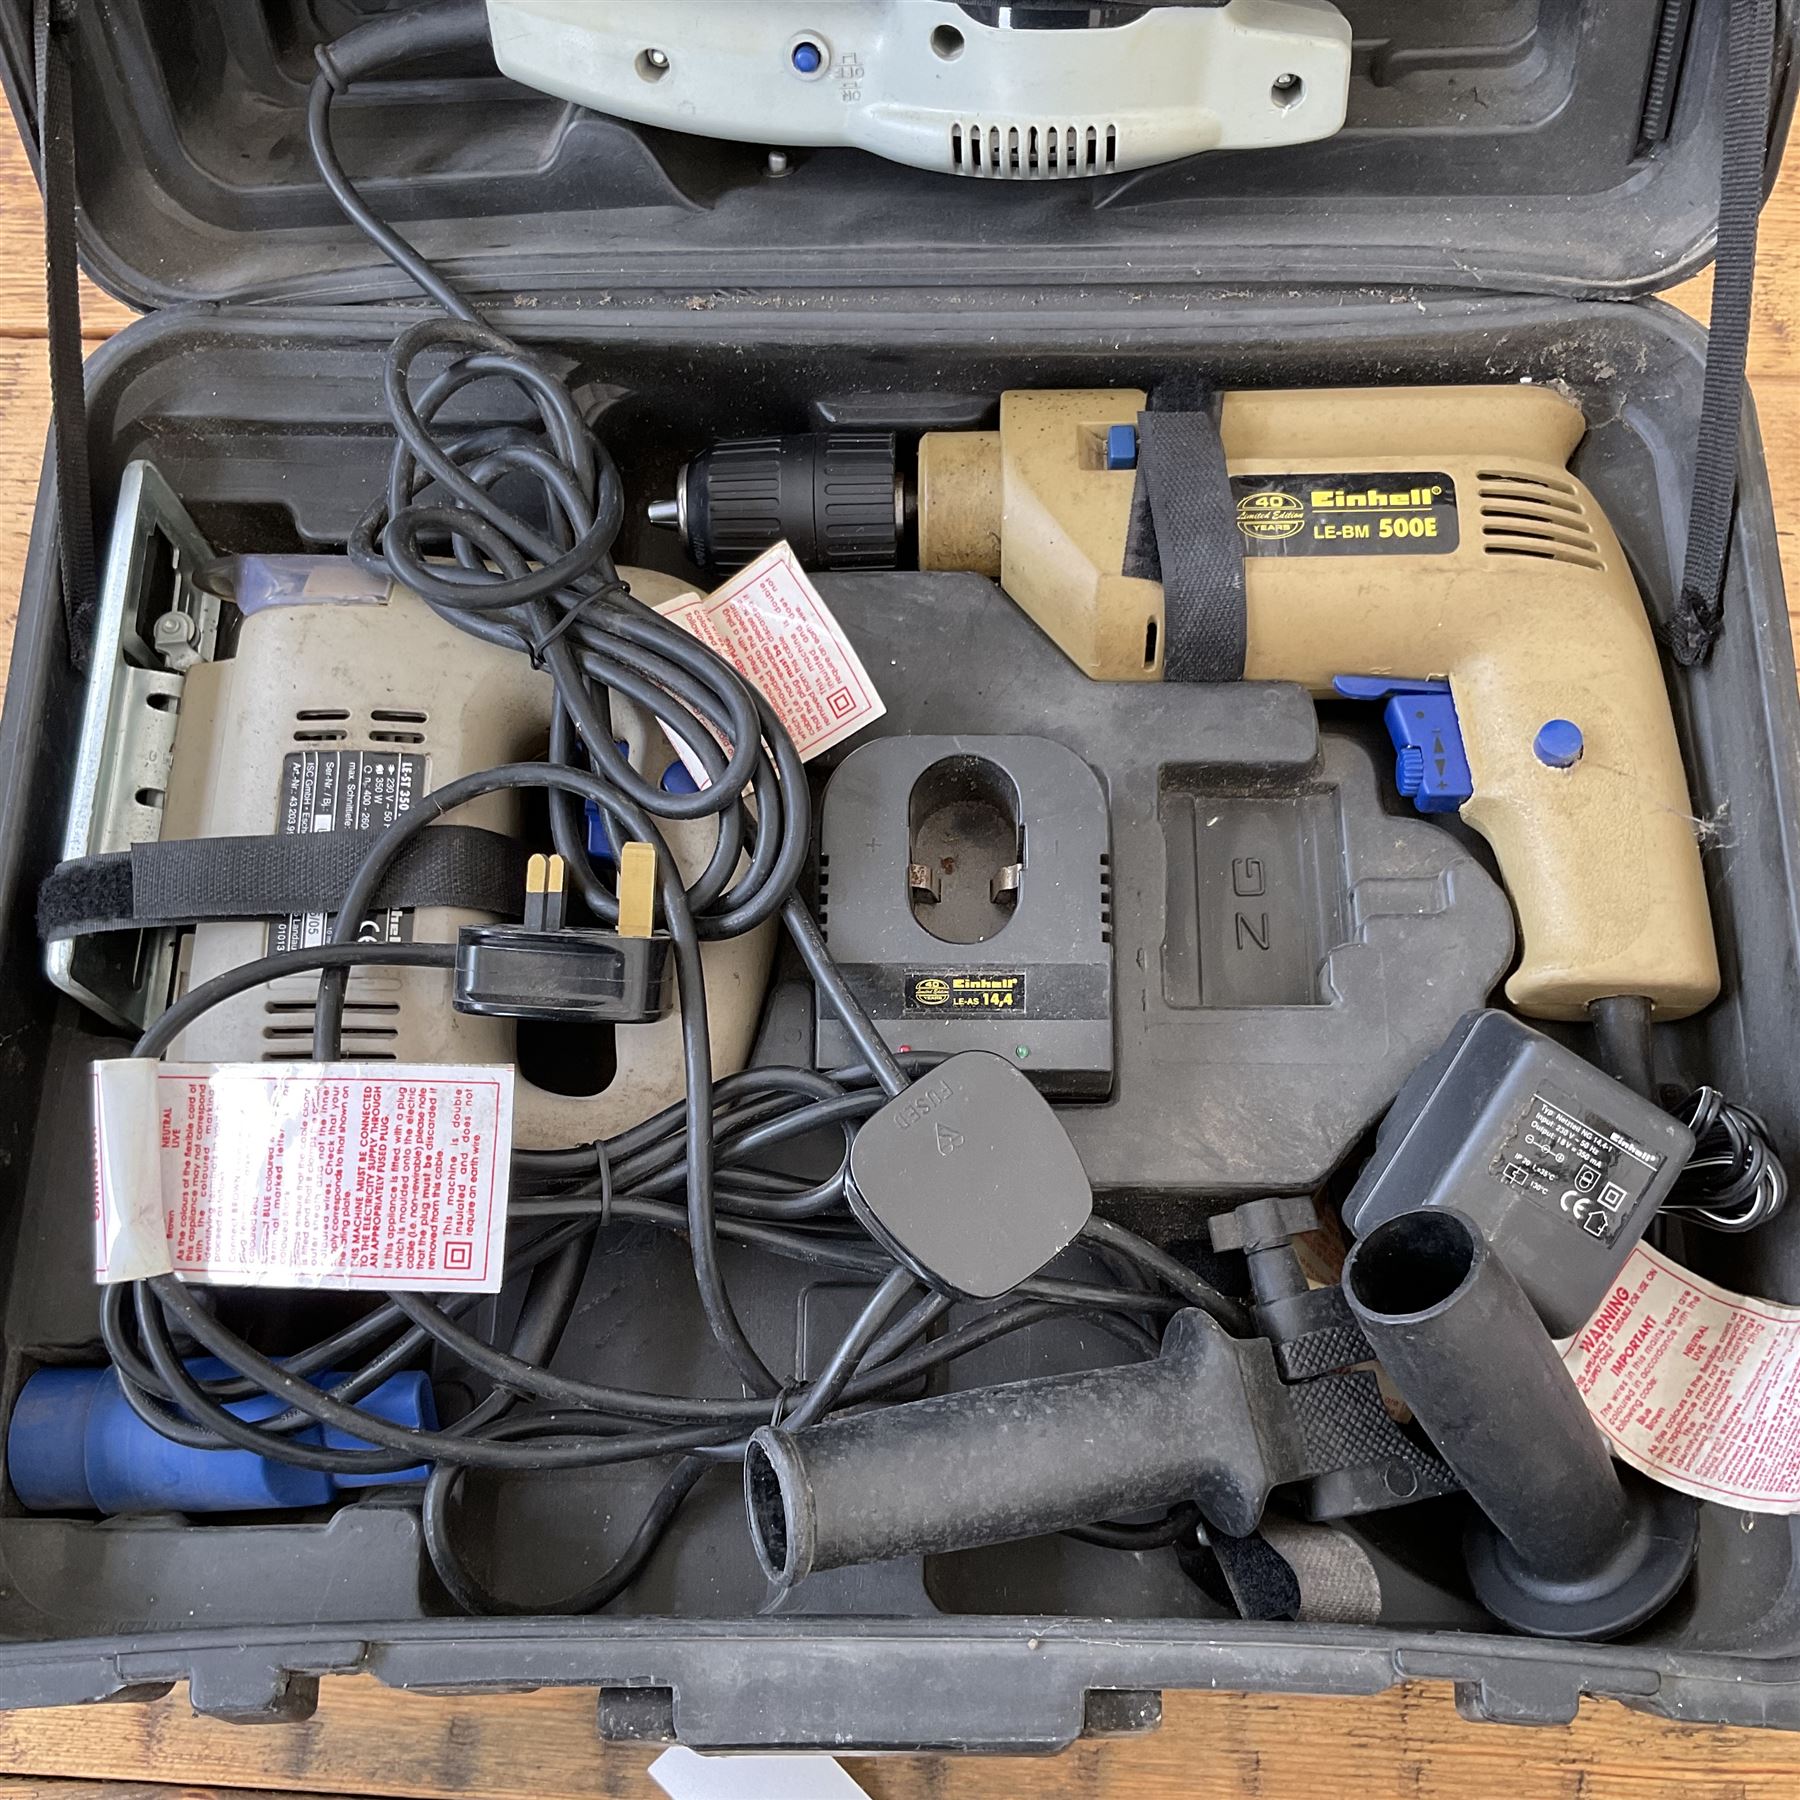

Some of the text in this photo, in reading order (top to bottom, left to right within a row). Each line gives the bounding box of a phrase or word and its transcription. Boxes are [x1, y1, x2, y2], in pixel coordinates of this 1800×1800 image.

[1237, 510, 1304, 520] Limited Edition
[1255, 496, 1284, 507] 40
[1252, 523, 1291, 532] YEARS
[1314, 517, 1438, 539] LE-BM 500E
[772, 644, 782, 657] be
[779, 658, 793, 678] must
[305, 761, 314, 777] ISC
[347, 761, 356, 780] max.
[303, 778, 313, 805] GmbH
[362, 789, 371, 806] 400
[374, 776, 383, 804] 350 W
[384, 777, 394, 822] 230 V 50
[398, 761, 412, 811] LE-ST 350
[276, 923, 287, 952] 01013
[290, 919, 300, 951] Landau
[953, 993, 1014, 1007] LE-AS 14,4
[195, 1083, 206, 1140] correspond
[397, 1086, 407, 1110] plug
[418, 1087, 427, 1109] note
[893, 1080, 954, 1130] FUSED
[161, 1108, 172, 1148] NEUTRAL
[396, 1112, 403, 1121] a
[415, 1111, 425, 1144] please
[425, 1097, 437, 1150] discarded
[462, 1115, 471, 1143] does
[1555, 1113, 1581, 1132] Netzteil
[1580, 1128, 1593, 1140] NG
[394, 1123, 402, 1144] with
[1530, 1120, 1556, 1139] Output:
[1576, 1148, 1590, 1160] 350
[1589, 1157, 1602, 1168] mA
[1535, 1111, 1599, 1155] Input: 230 V 50 Hz
[352, 1085, 372, 1244] MACHINE MUST BE CONNECTED
[376, 1143, 386, 1173] FUSED
[423, 1154, 432, 1168] be
[443, 1088, 462, 1235] This machine is double
[459, 1152, 468, 1175] and
[470, 1156, 478, 1183] earth
[165, 1129, 180, 1239] Brown LIVE
[177, 1083, 196, 1261] As the colours of the flexible cord of
[192, 1163, 201, 1187] may
[359, 1085, 381, 1268] TO THE ELECTRICITY SUPPLY THROUGH
[390, 1175, 398, 1183] is
[396, 1087, 416, 1269] which is moulded onto the electric
[410, 1145, 423, 1218] non-rewirable)
[422, 1172, 431, 1199] must
[432, 1181, 441, 1198] this
[469, 1184, 476, 1199] an
[188, 1189, 198, 1242] appliance
[370, 1174, 384, 1250] APPROPRIATELY
[387, 1185, 398, 1239] appliance
[420, 1202, 430, 1226] plug
[430, 1199, 439, 1223] from
[466, 1200, 476, 1236] require
[384, 1242, 393, 1259] this
[418, 1229, 426, 1246] the
[428, 1224, 438, 1270] removed
[185, 1245, 194, 1261] this
[370, 1252, 378, 1267] AN
[406, 1240, 415, 1269] cable
[416, 1249, 425, 1270] that
[1646, 1268, 1657, 1281] ON
[1578, 1286, 1629, 1353] WARNING
[1610, 1315, 1656, 1376] IMPORTANT
[1683, 1326, 1709, 1356] NEUTRAL
[1691, 1344, 1707, 1361] LIVE
